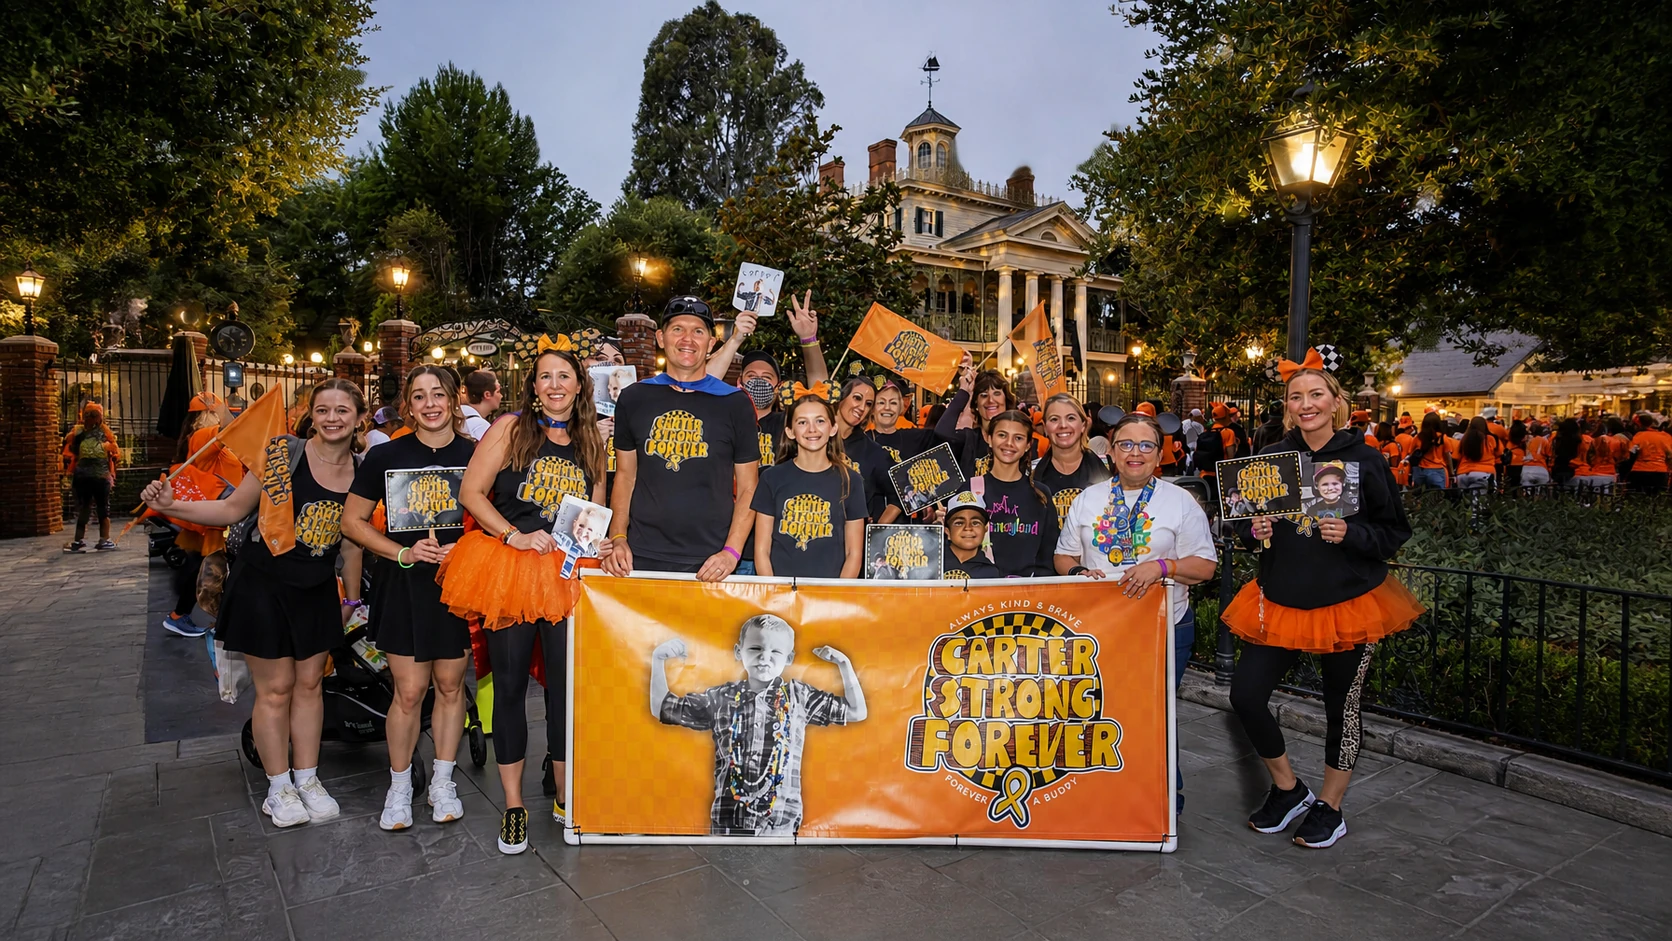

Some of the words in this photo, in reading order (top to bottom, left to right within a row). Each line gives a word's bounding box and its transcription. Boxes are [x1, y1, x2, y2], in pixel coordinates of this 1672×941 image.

[647, 440, 708, 459] FOREVER
[949, 603, 995, 631] ALWAYS
[1000, 599, 1031, 610] KIND
[1036, 601, 1044, 611] &
[1047, 604, 1083, 629] BRAVE
[936, 636, 1096, 676] CARTER
[934, 676, 1096, 720] STRONG
[915, 718, 1120, 768] FOREVER
[944, 774, 988, 805] FOREVER
[1032, 796, 1041, 806] A
[1044, 776, 1079, 803] BUDDY
